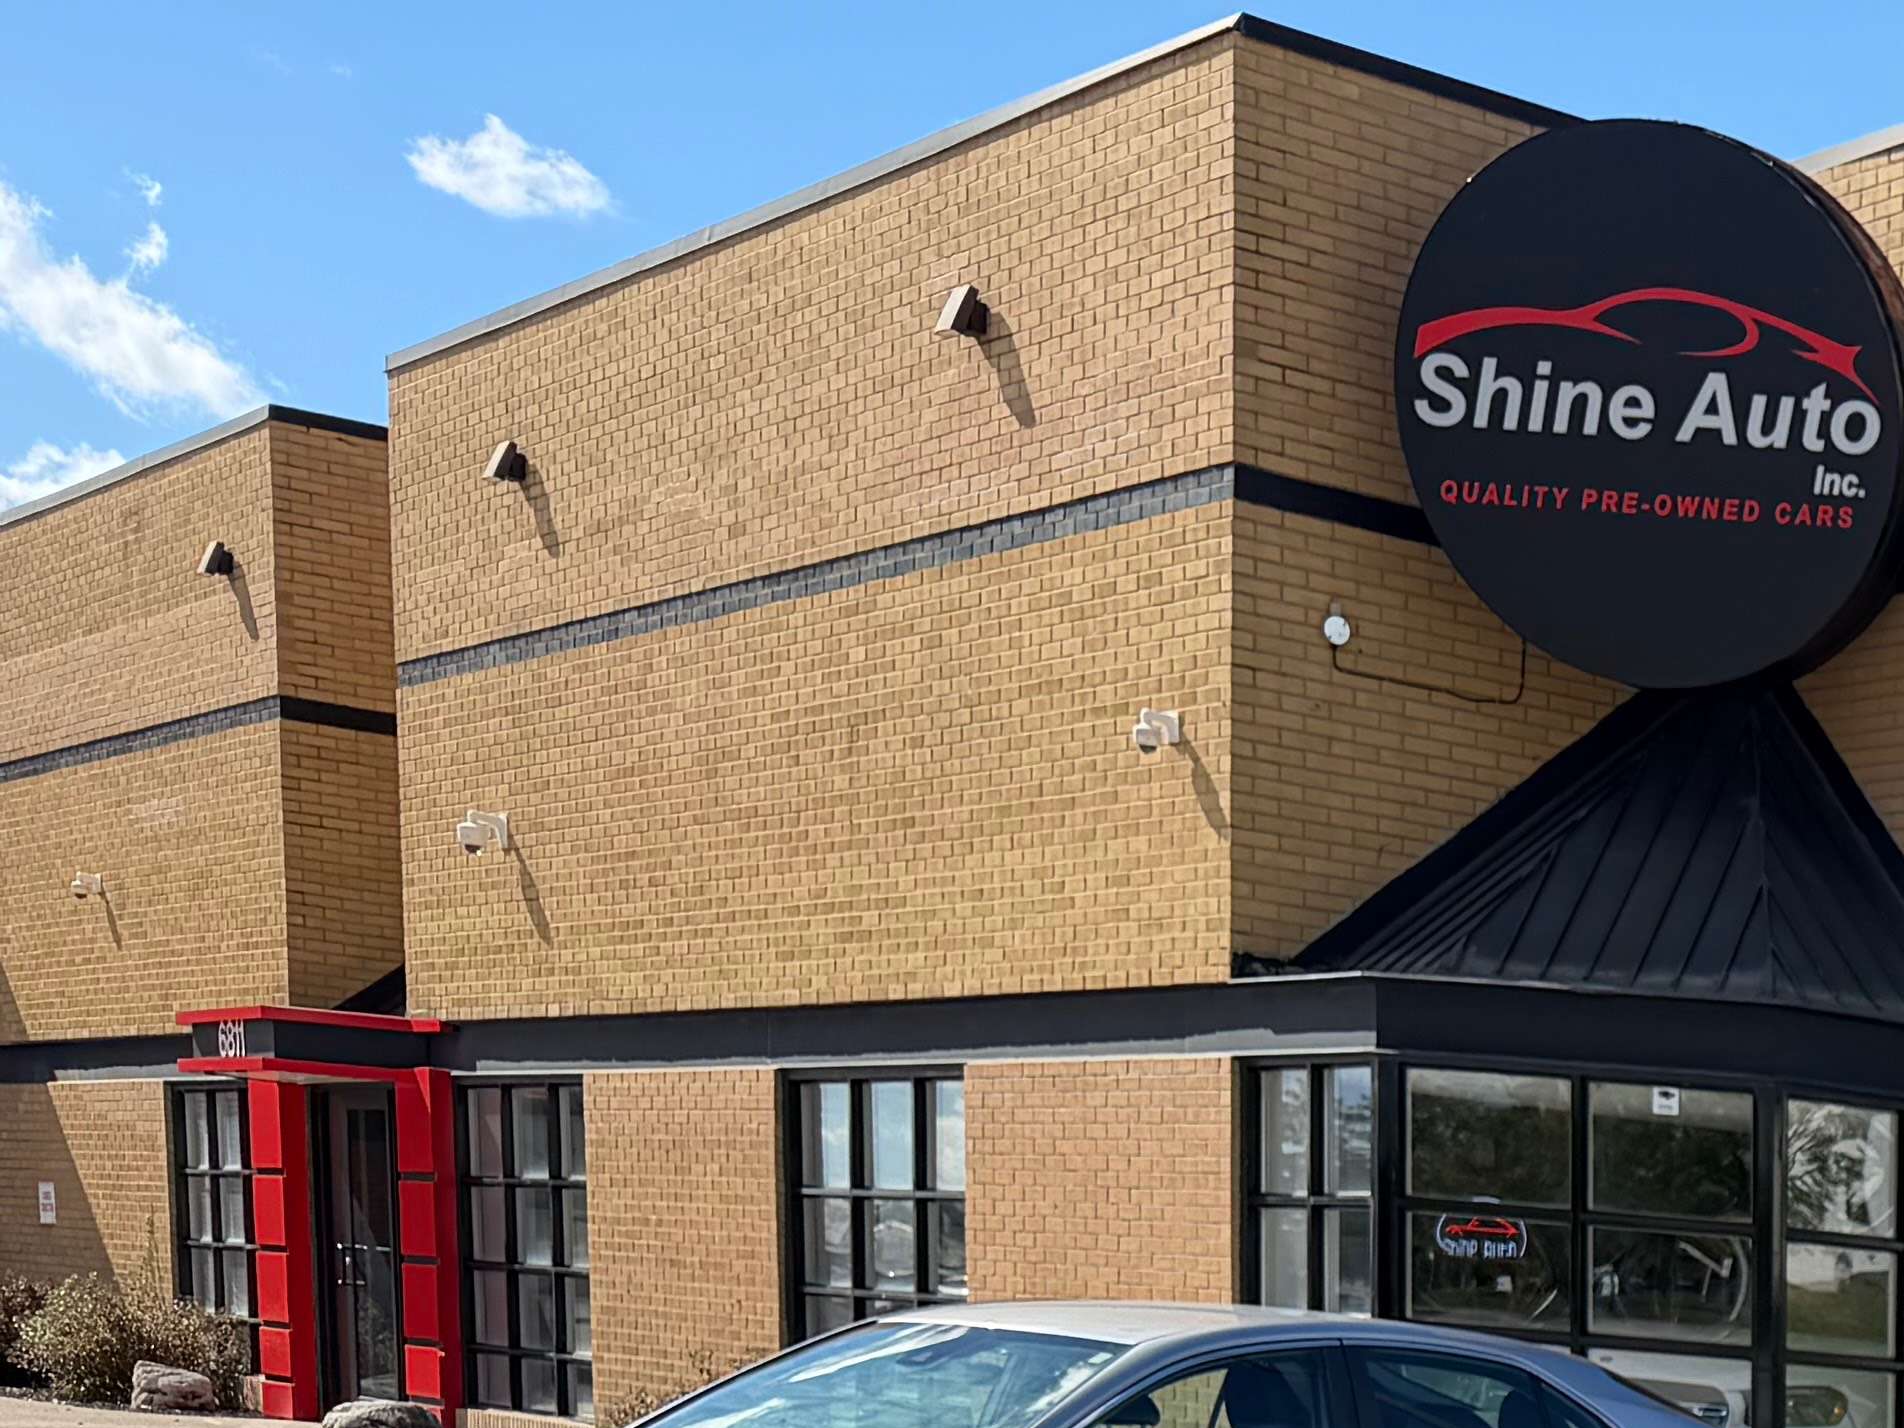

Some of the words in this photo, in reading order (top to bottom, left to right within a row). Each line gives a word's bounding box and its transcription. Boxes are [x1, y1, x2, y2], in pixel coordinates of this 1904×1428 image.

[1413, 352, 1656, 441] Shine
[1675, 372, 1882, 456] Auto
[1439, 479, 1569, 512] QUALITY
[1581, 488, 1761, 523] PRE-OWNED
[1774, 501, 1854, 529] CARS
[1813, 465, 1867, 499] Inc.
[218, 1018, 246, 1059] 6811
